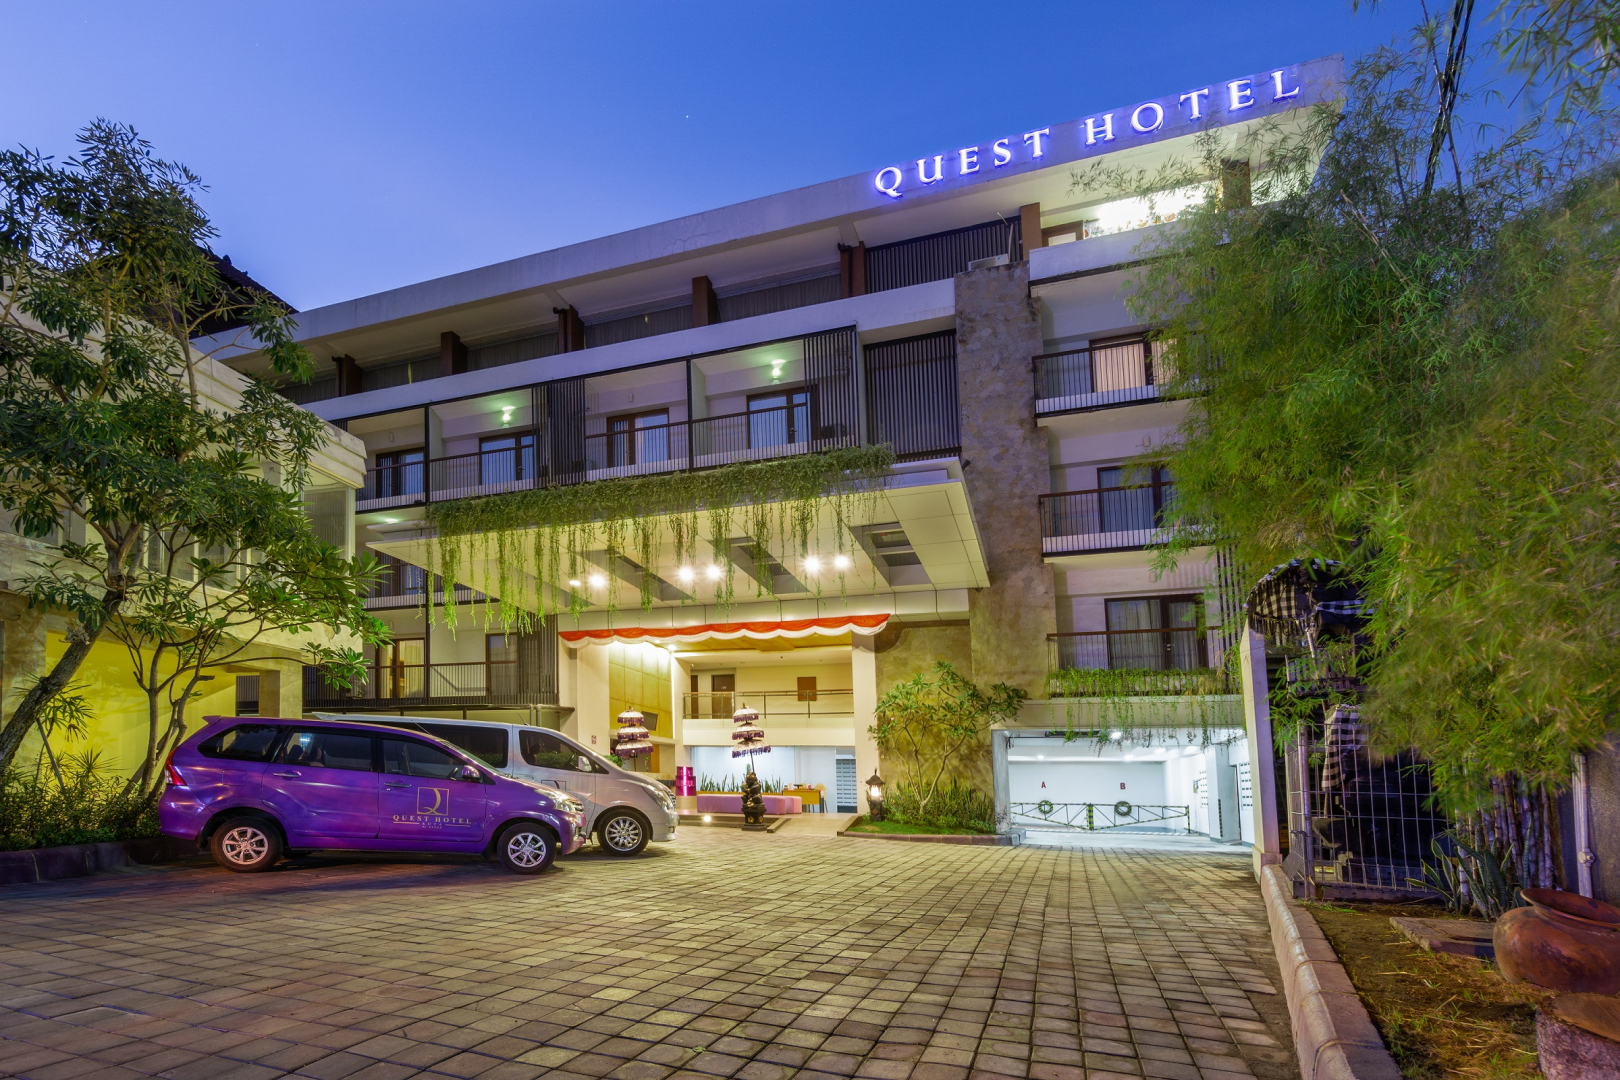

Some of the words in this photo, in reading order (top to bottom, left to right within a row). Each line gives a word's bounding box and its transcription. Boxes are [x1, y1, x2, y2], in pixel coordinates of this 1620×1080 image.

[873, 127, 1050, 198] QUEST
[1083, 70, 1300, 145] HOTEL
[1120, 782, 1126, 790] B
[392, 814, 430, 822] QUEST
[435, 816, 472, 824] HOTEL
